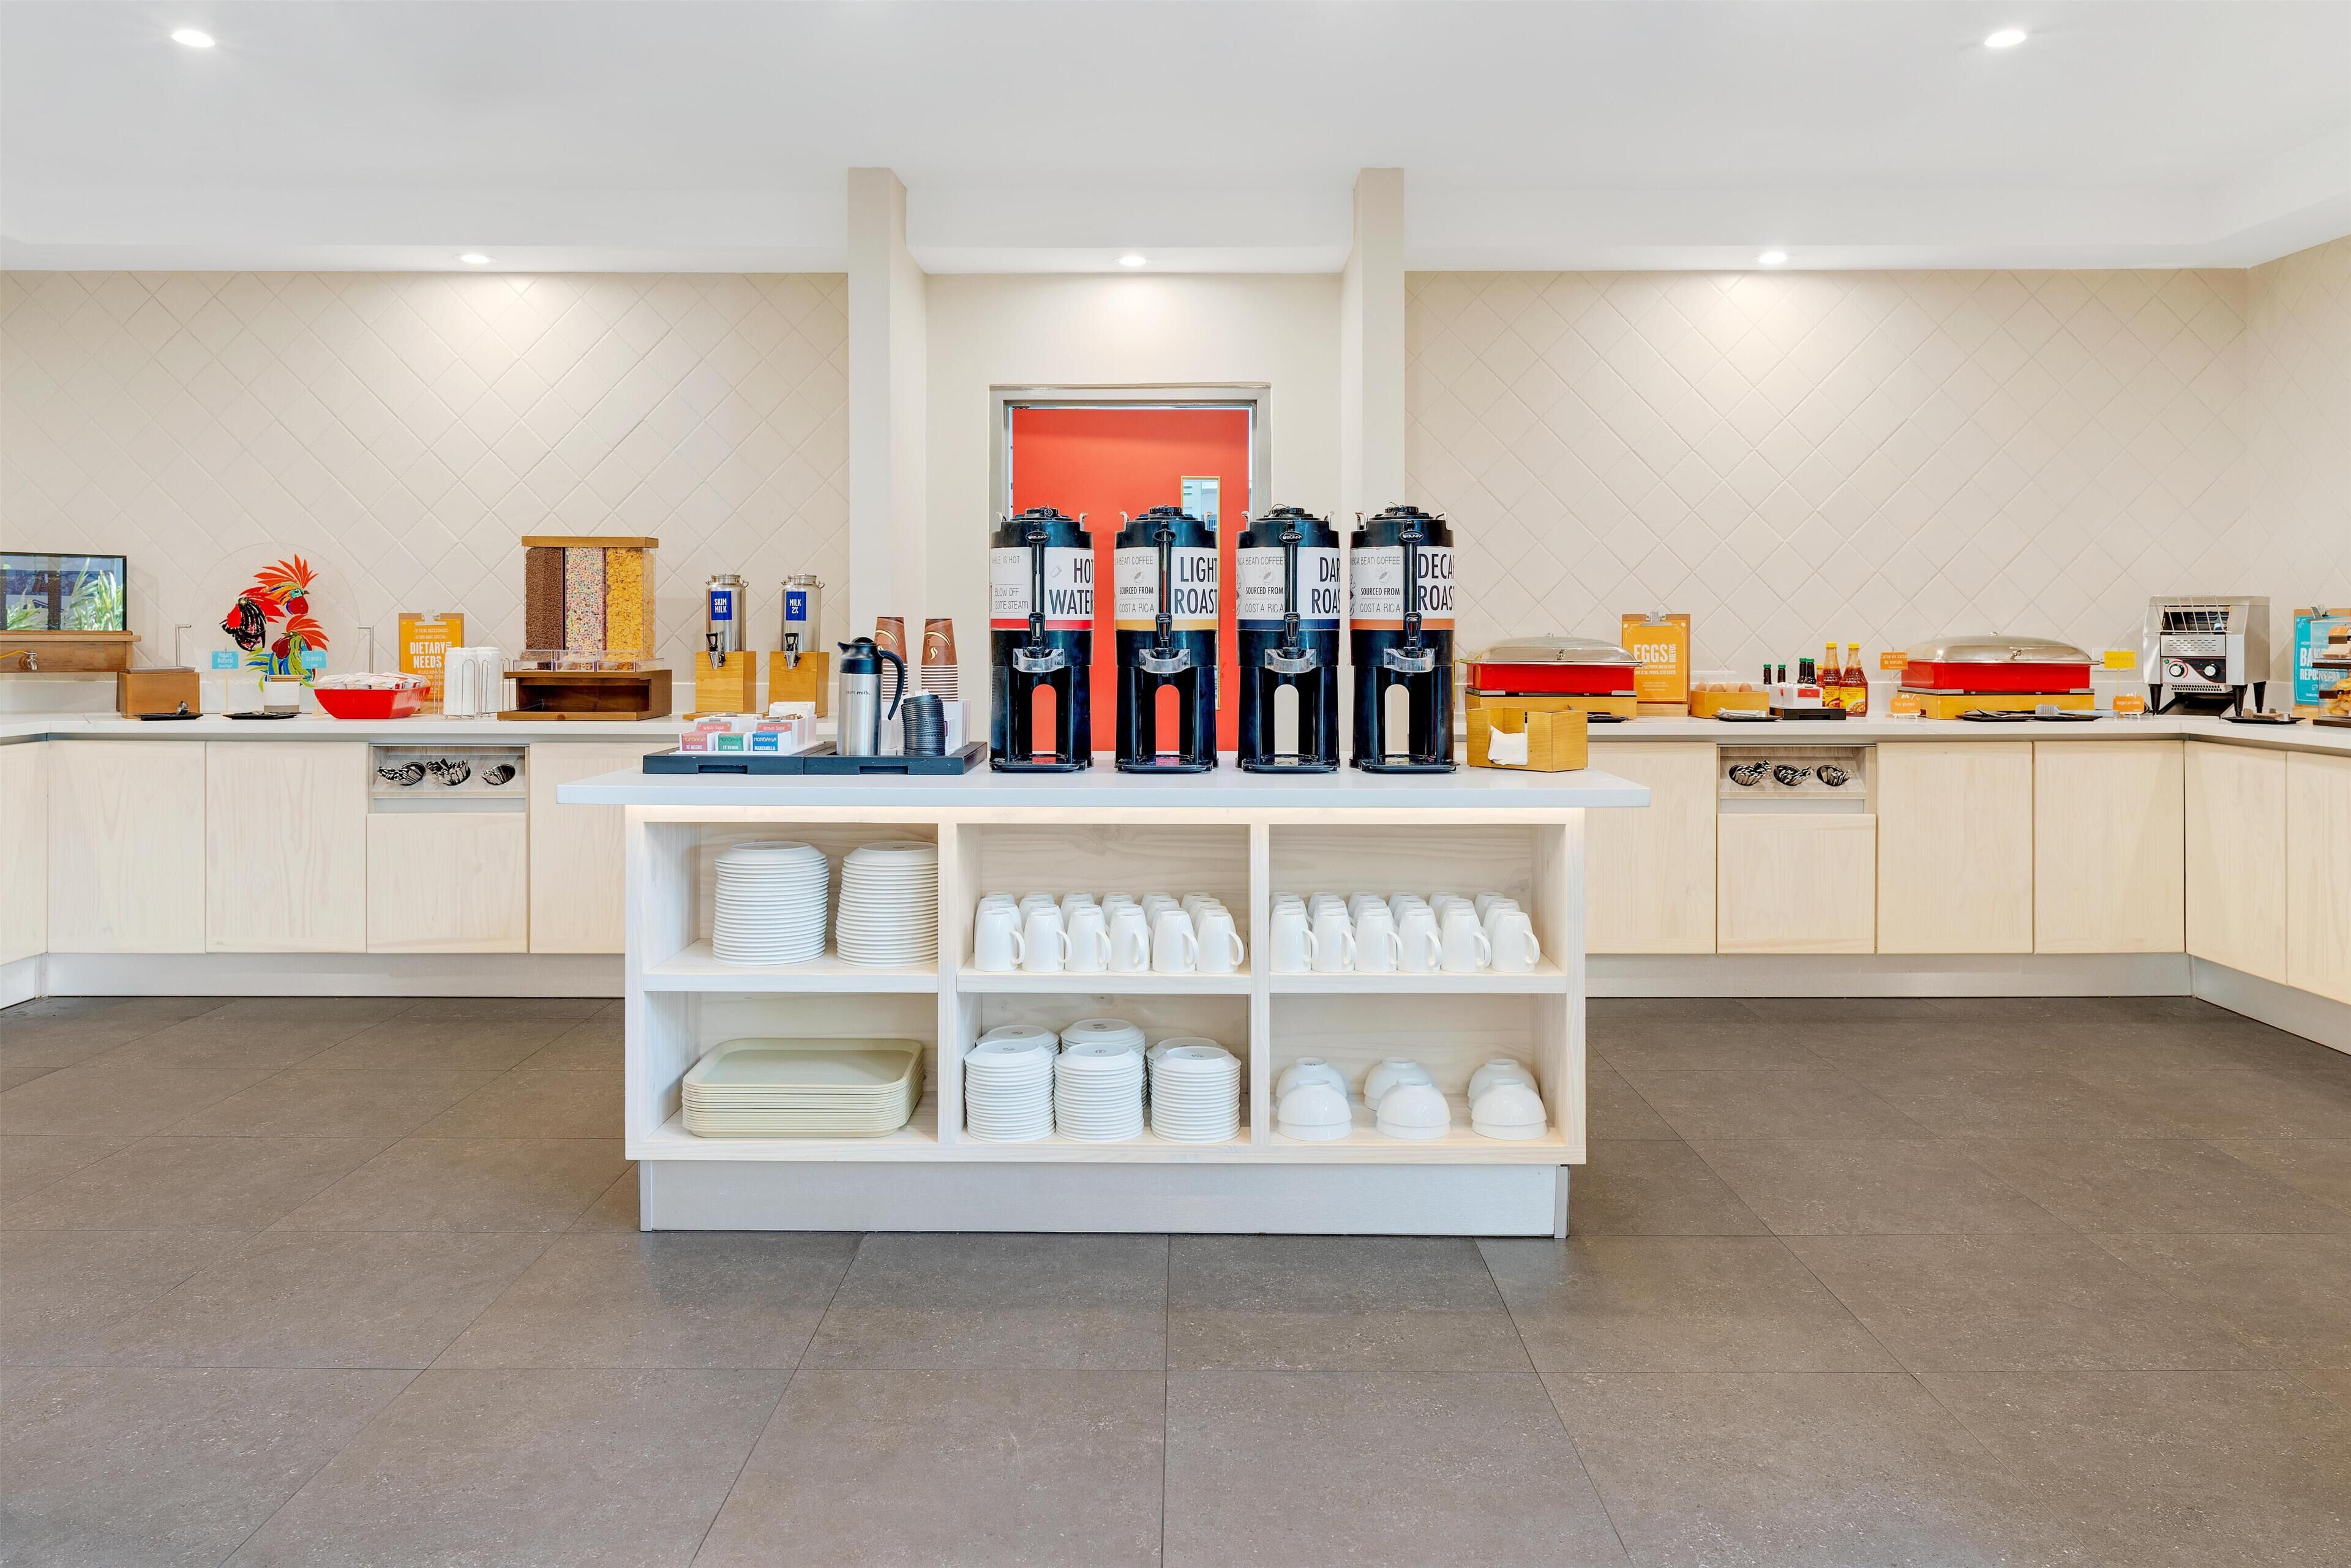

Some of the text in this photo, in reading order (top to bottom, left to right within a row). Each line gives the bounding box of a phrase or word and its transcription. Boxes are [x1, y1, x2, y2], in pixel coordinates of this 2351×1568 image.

[1009, 555, 1020, 564] HOT
[1119, 557, 1130, 565] BEAN
[1131, 556, 1154, 565] COFFEE
[1245, 557, 1259, 565] BEAN
[1261, 556, 1284, 565] COFFEE
[1361, 557, 1375, 565] BEAN
[1376, 556, 1400, 565] COFFEE
[1074, 558, 1094, 583] HOT
[1180, 557, 1218, 583] LIGHT
[1319, 557, 1340, 582] DAR
[995, 588, 1019, 597] BLOW OFF
[1119, 587, 1137, 595] SOURCED
[1245, 587, 1266, 595] SOURCED
[1360, 587, 1382, 596] SOURCED
[995, 600, 1029, 609] SOME STEAM
[1049, 590, 1094, 615] WATER
[1174, 588, 1218, 614] ROAST
[1311, 588, 1340, 614] ROAS
[1119, 603, 1155, 613] COSTA RICA
[1245, 603, 1284, 613] COSTA RICA
[1360, 603, 1401, 613] COSTA RICA
[410, 641, 446, 655] DIETARY
[1633, 643, 1668, 662] EGGS
[413, 655, 442, 669] NEEDS
